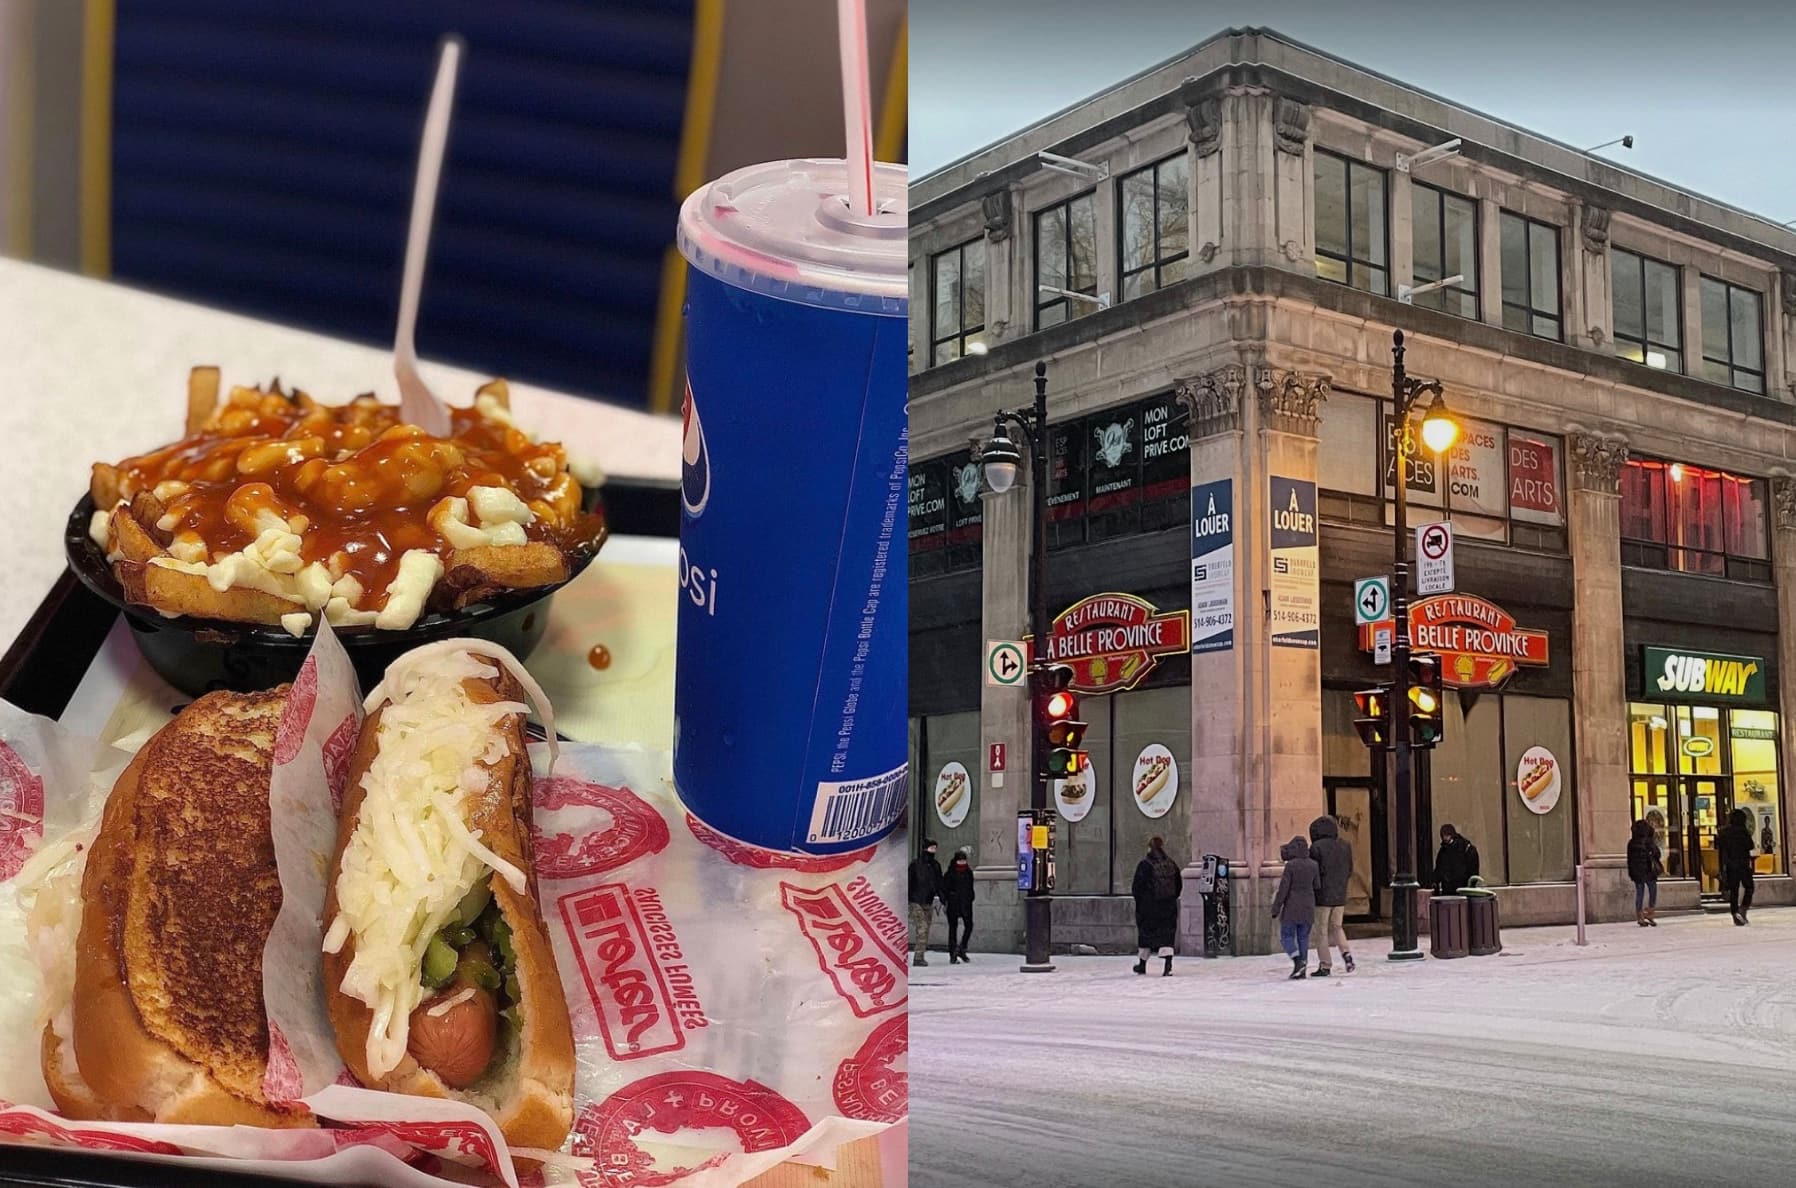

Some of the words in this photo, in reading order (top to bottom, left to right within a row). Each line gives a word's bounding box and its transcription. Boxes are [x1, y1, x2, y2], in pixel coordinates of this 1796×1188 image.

[1144, 406, 1168, 424] MON
[1144, 423, 1168, 441] LOFT
[1451, 449, 1471, 462] DES
[1511, 448, 1538, 470] DES
[1289, 488, 1299, 512] À
[1451, 482, 1479, 499] COM
[1511, 478, 1553, 506] ARTS
[1208, 493, 1216, 514] À
[879, 492, 900, 539] trademarks
[1196, 513, 1229, 538] LOUER
[1274, 510, 1314, 534] LOUER
[872, 541, 890, 582] registered
[869, 583, 881, 598] are
[863, 598, 879, 615] Cap
[1065, 601, 1136, 630] RESTAURANT
[1425, 602, 1502, 627] RESTAURANT
[858, 616, 874, 640] Bottle
[1059, 634, 1092, 657] BELLE
[1098, 623, 1162, 650] PROVINCE
[1418, 624, 1459, 649] BELLE
[1465, 630, 1528, 657] PROVINCE
[853, 641, 869, 662] Pepsi
[1657, 654, 1758, 695] SUBWAY
[843, 693, 859, 714] Globe
[838, 715, 854, 736] Pepsi
[1139, 756, 1153, 766] Hot
[1155, 755, 1171, 767] Dog
[1523, 757, 1537, 765] Hot
[1539, 757, 1554, 769] Dog
[809, 833, 818, 842] 0
